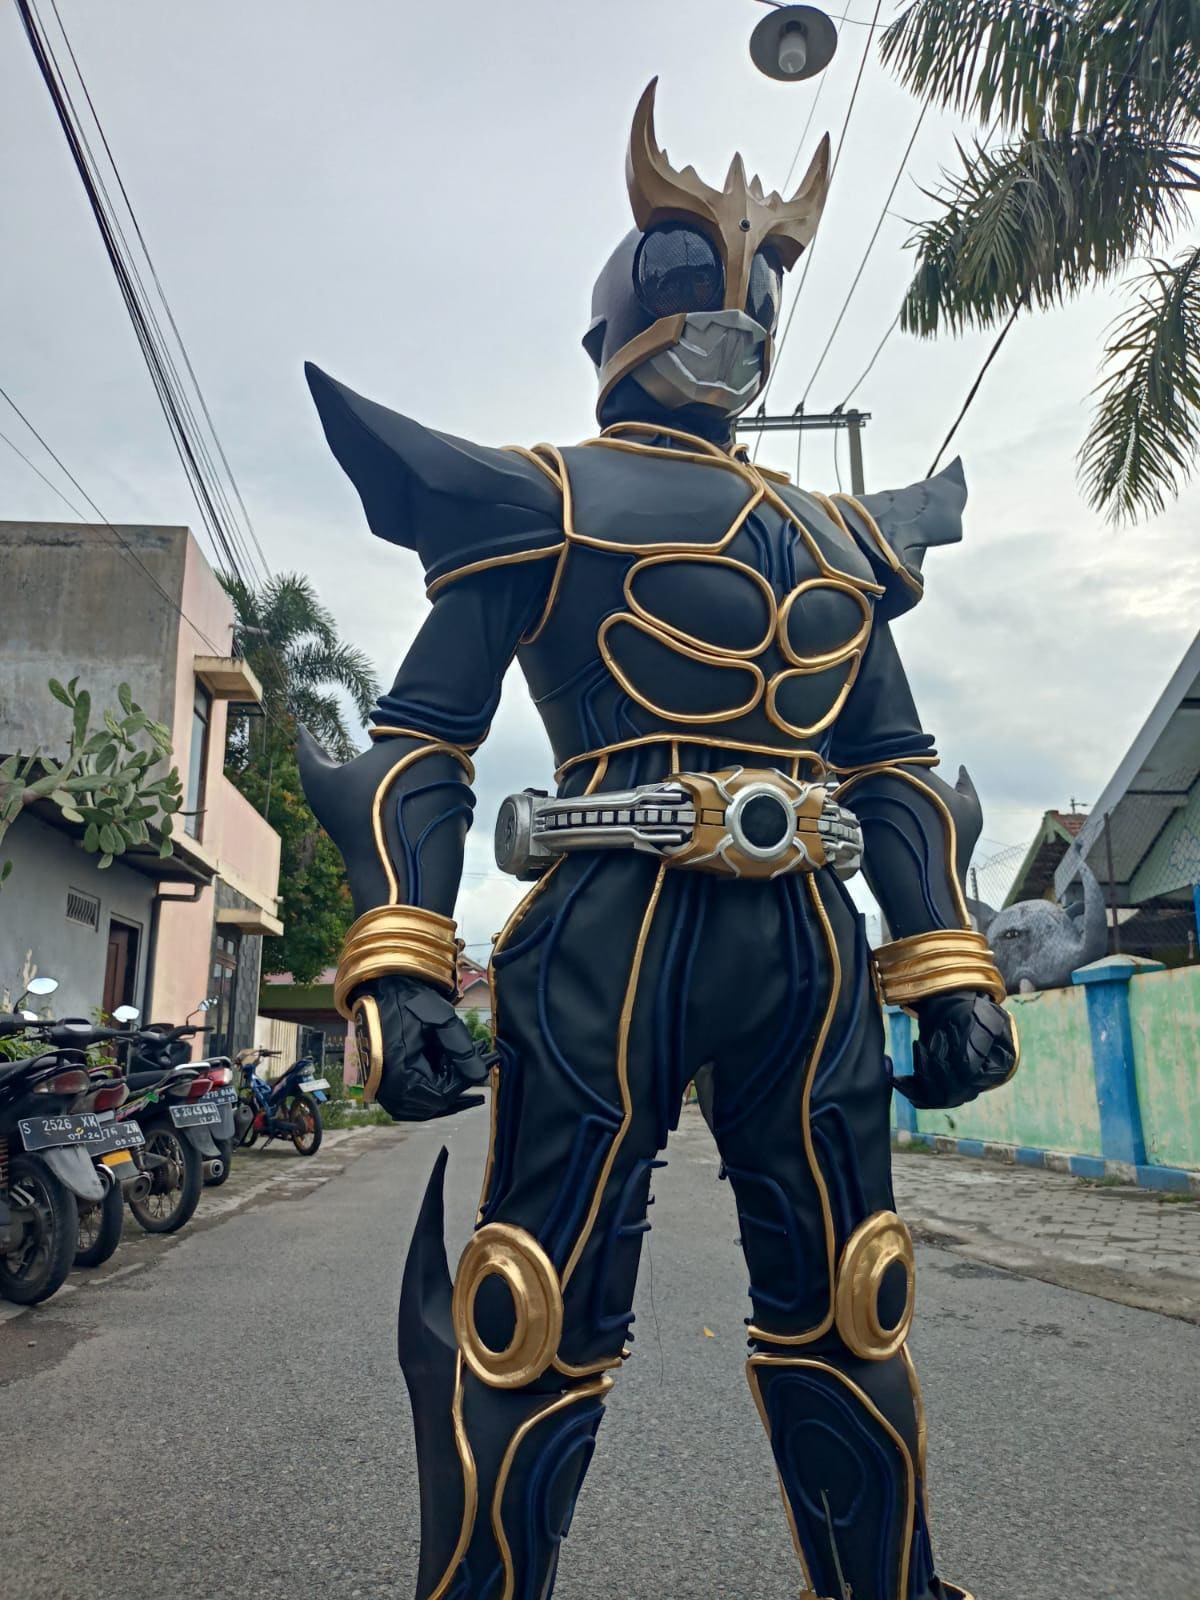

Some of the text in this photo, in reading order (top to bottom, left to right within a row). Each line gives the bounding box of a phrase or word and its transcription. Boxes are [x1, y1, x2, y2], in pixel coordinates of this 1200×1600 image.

[173, 1109, 180, 1117] S
[22, 1122, 32, 1134] S
[42, 1118, 72, 1131] 2526
